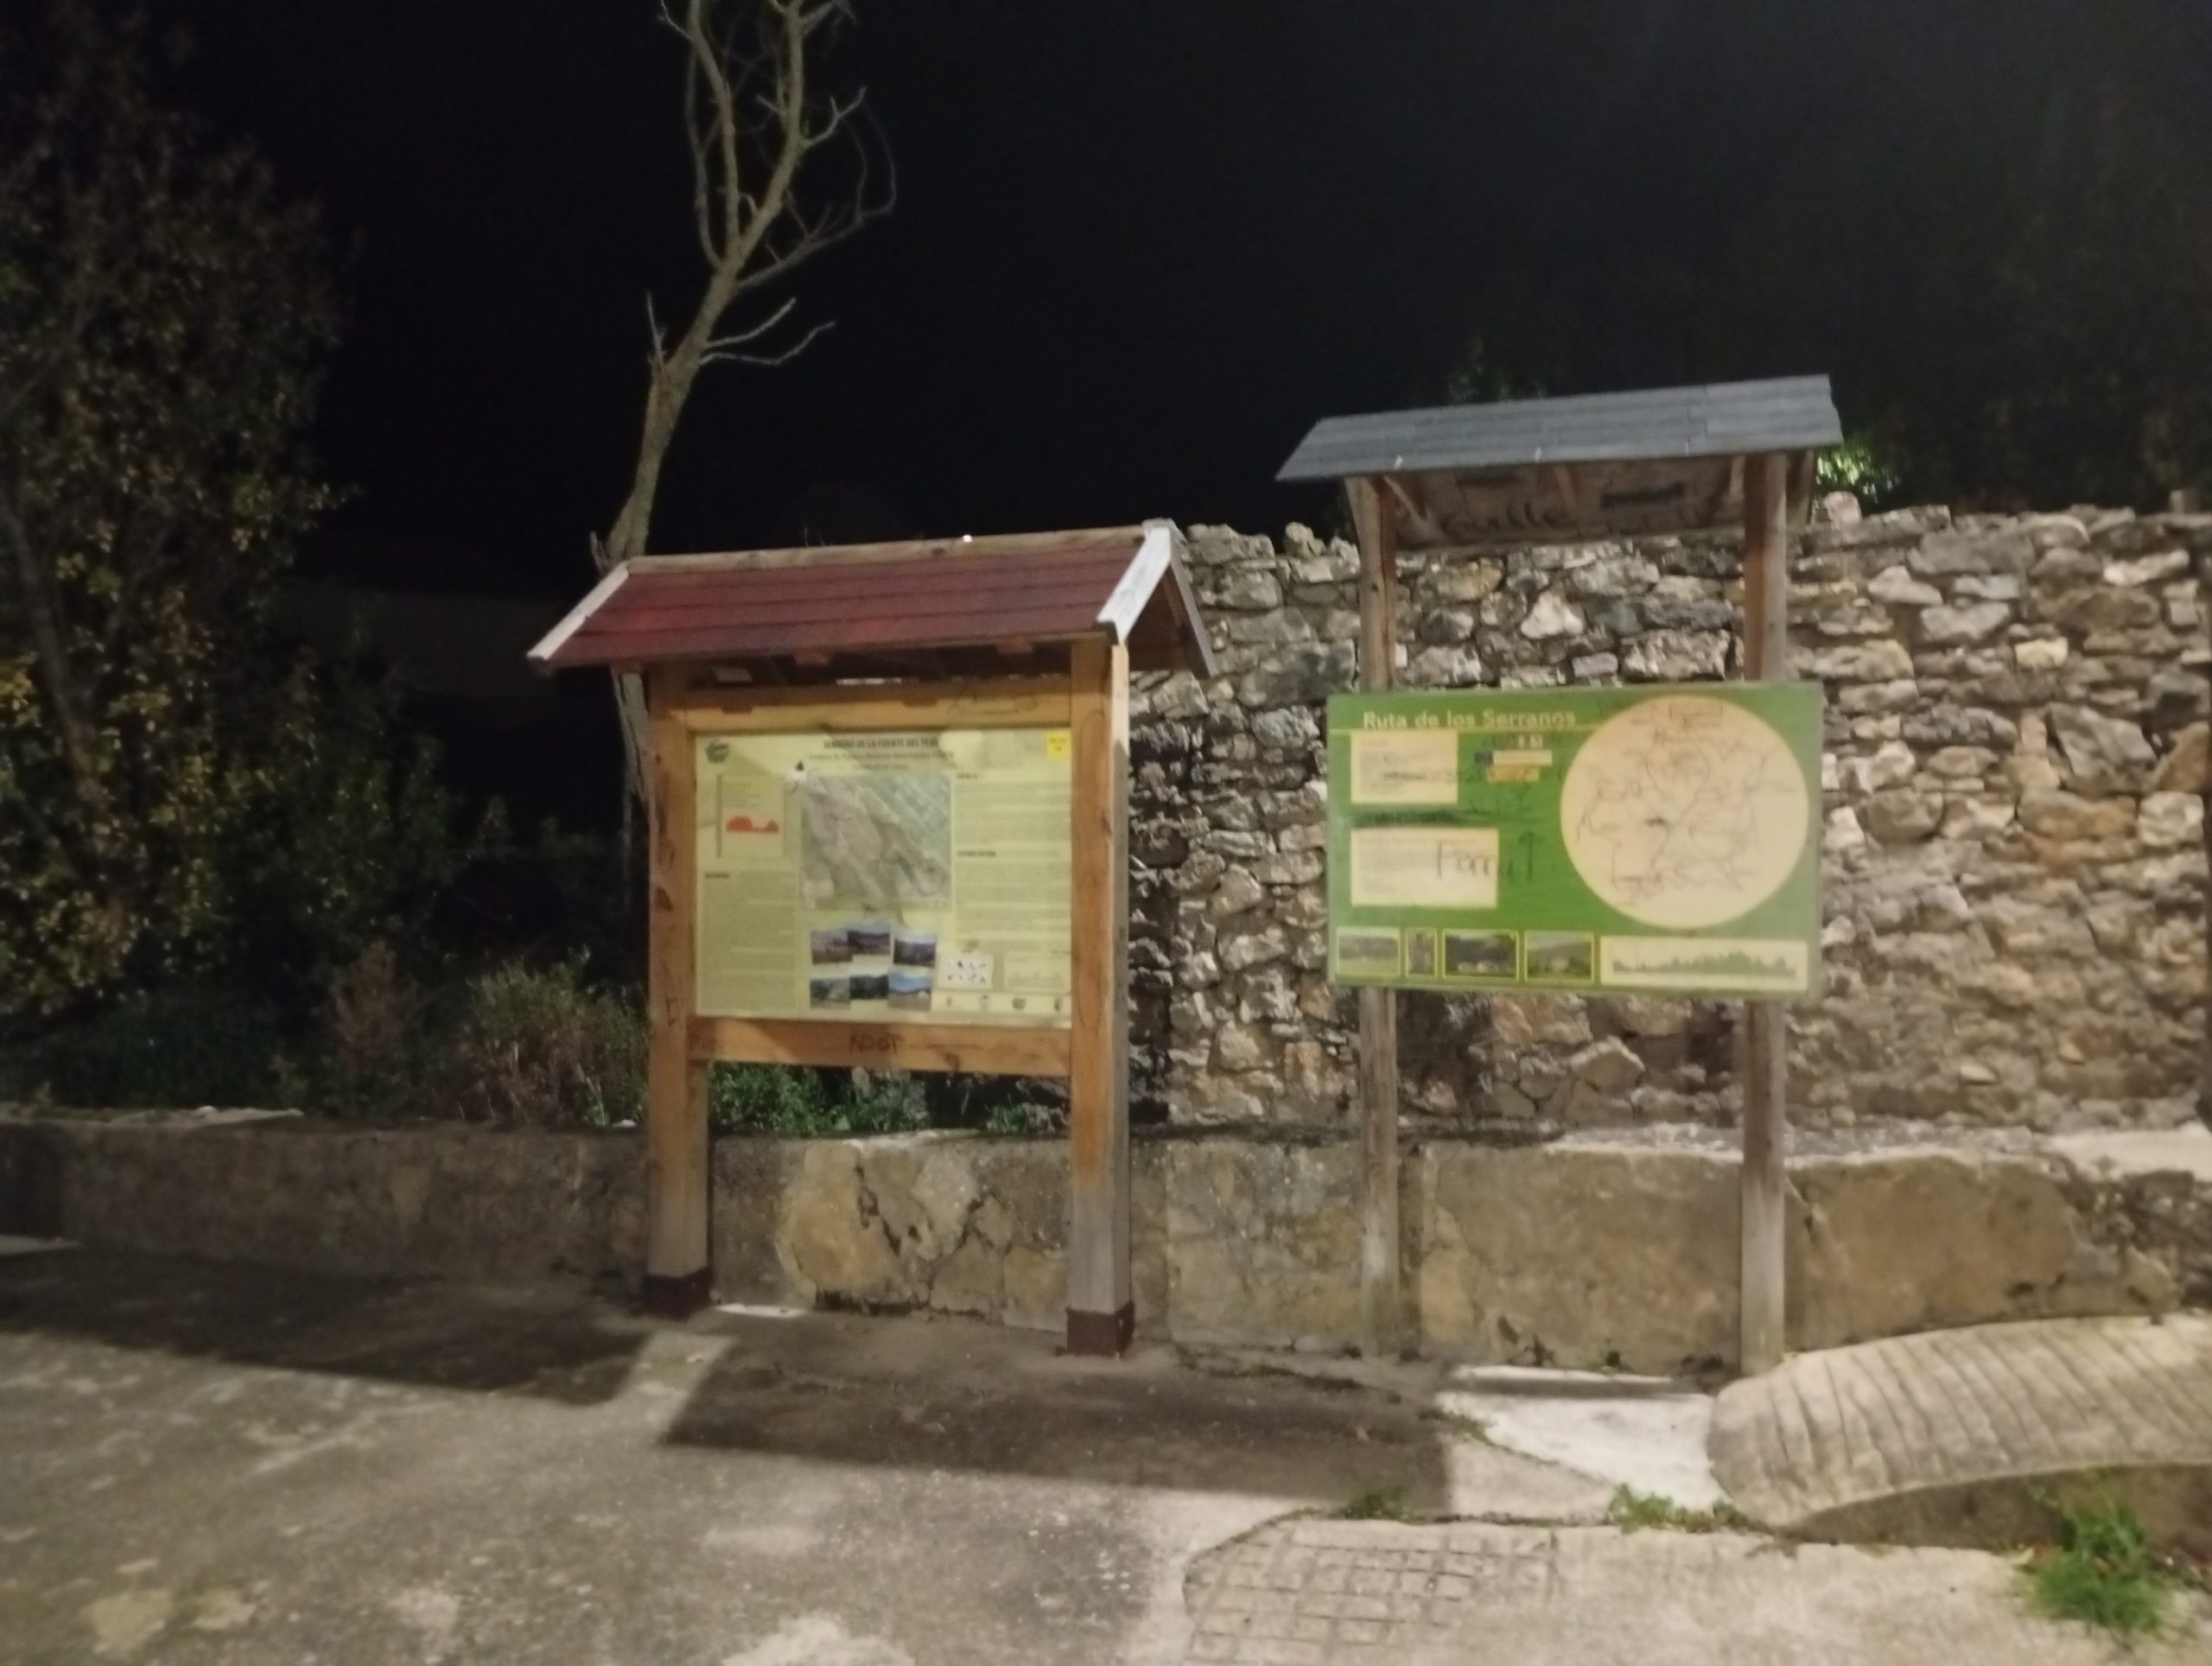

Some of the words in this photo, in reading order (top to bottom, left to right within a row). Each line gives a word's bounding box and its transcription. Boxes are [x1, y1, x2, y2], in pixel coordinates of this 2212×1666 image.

[1363, 710, 1408, 729] Ruta
[1414, 710, 1440, 728] de
[1446, 709, 1476, 728] los
[1482, 709, 1576, 728] Serranos
